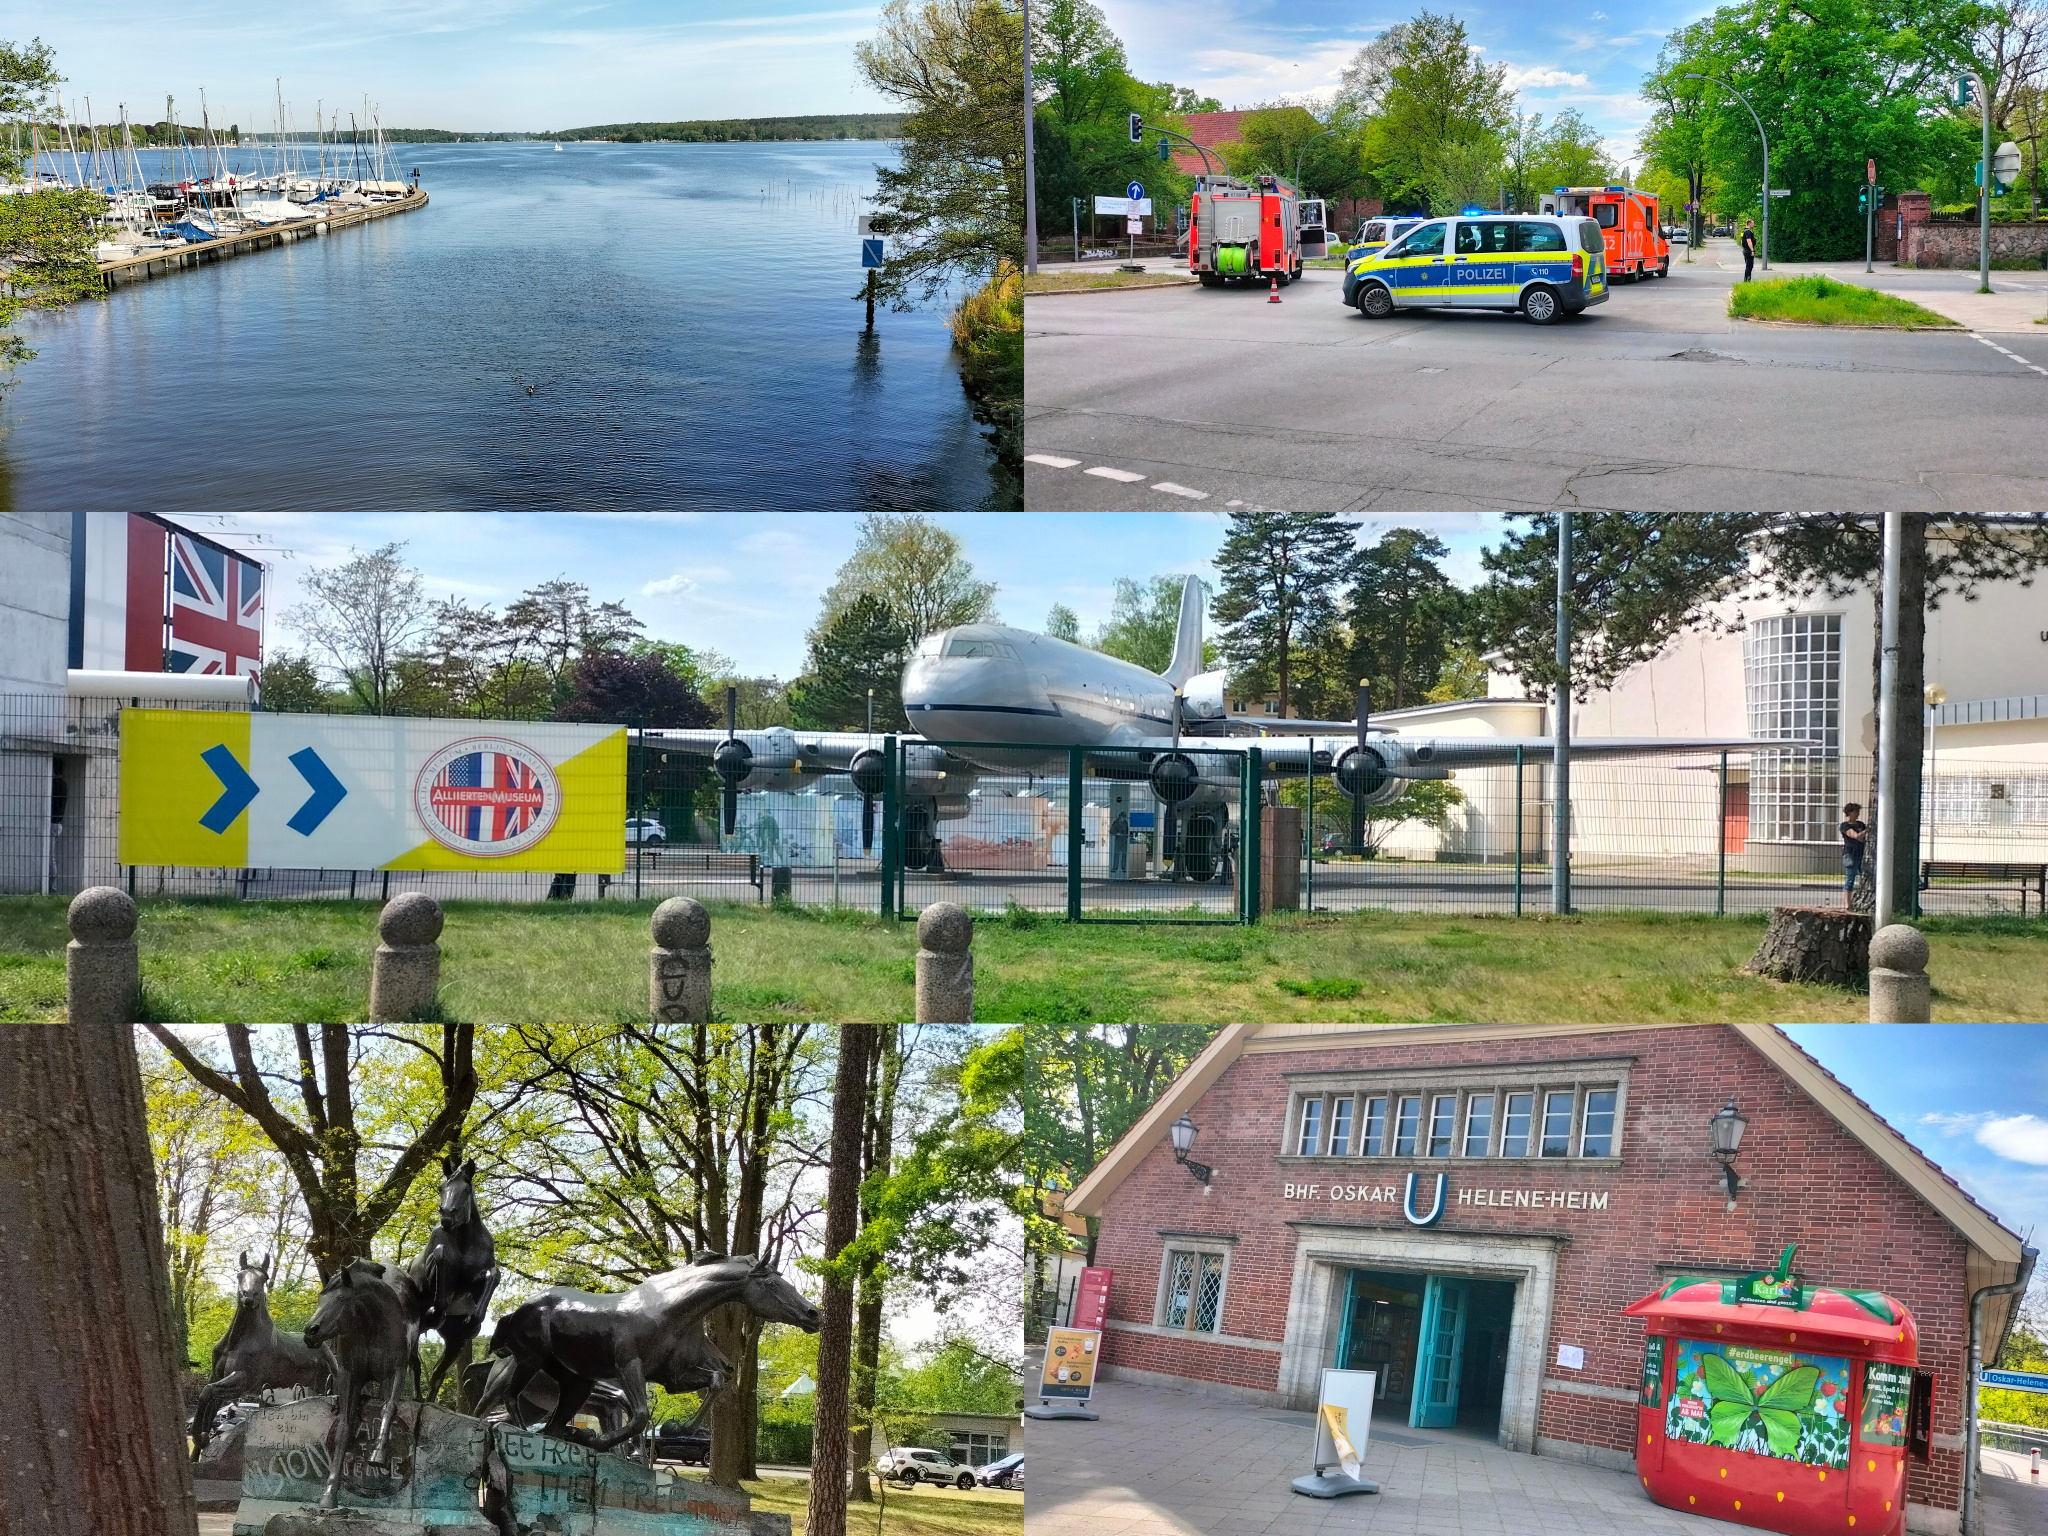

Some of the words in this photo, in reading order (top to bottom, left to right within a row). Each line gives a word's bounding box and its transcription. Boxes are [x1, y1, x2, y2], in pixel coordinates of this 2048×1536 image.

[1627, 231, 1643, 257] 112
[1457, 268, 1506, 280] POLIZEI
[472, 743, 507, 752] BERLIN
[1284, 1183, 1321, 1200] BHF.
[1330, 1185, 1397, 1202] OSKAR
[1458, 1189, 1609, 1210] HELENE-HEIM
[1404, 1172, 1448, 1225] U
[1754, 1284, 1784, 1296] Karls
[1728, 1348, 1793, 1365] #erdbeerengel
[1869, 1367, 1896, 1383] Komm
[1980, 1372, 1988, 1382] U
[1992, 1375, 2048, 1388] Oskar-Helene-
[1691, 1410, 1703, 1418] MAI
